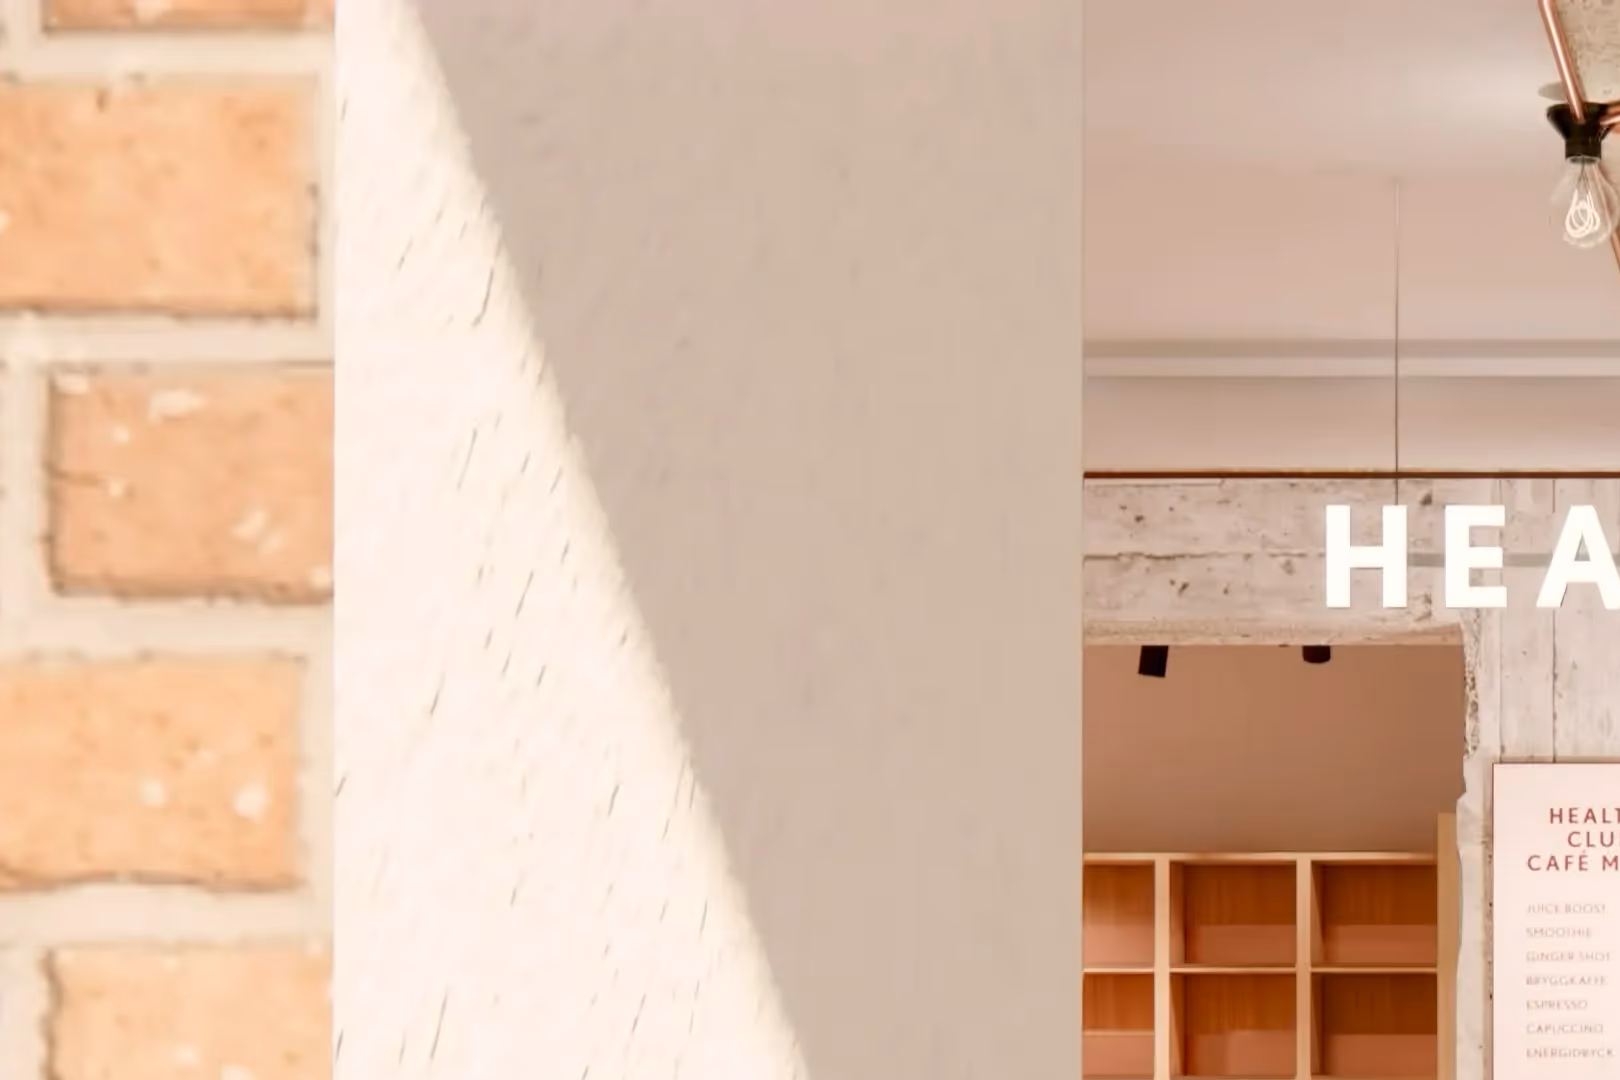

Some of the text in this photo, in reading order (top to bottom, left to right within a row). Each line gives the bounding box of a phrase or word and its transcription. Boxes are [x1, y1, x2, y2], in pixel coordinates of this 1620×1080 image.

[1526, 849, 1590, 872] CAFÉ
[1526, 903, 1560, 915] JUICE
[1564, 903, 1606, 915] BOOST
[1525, 927, 1592, 939] SMOOTHIE
[1525, 999, 1589, 1011] ESPRESSO
[1525, 1023, 1605, 1035] CAPUCCINO
